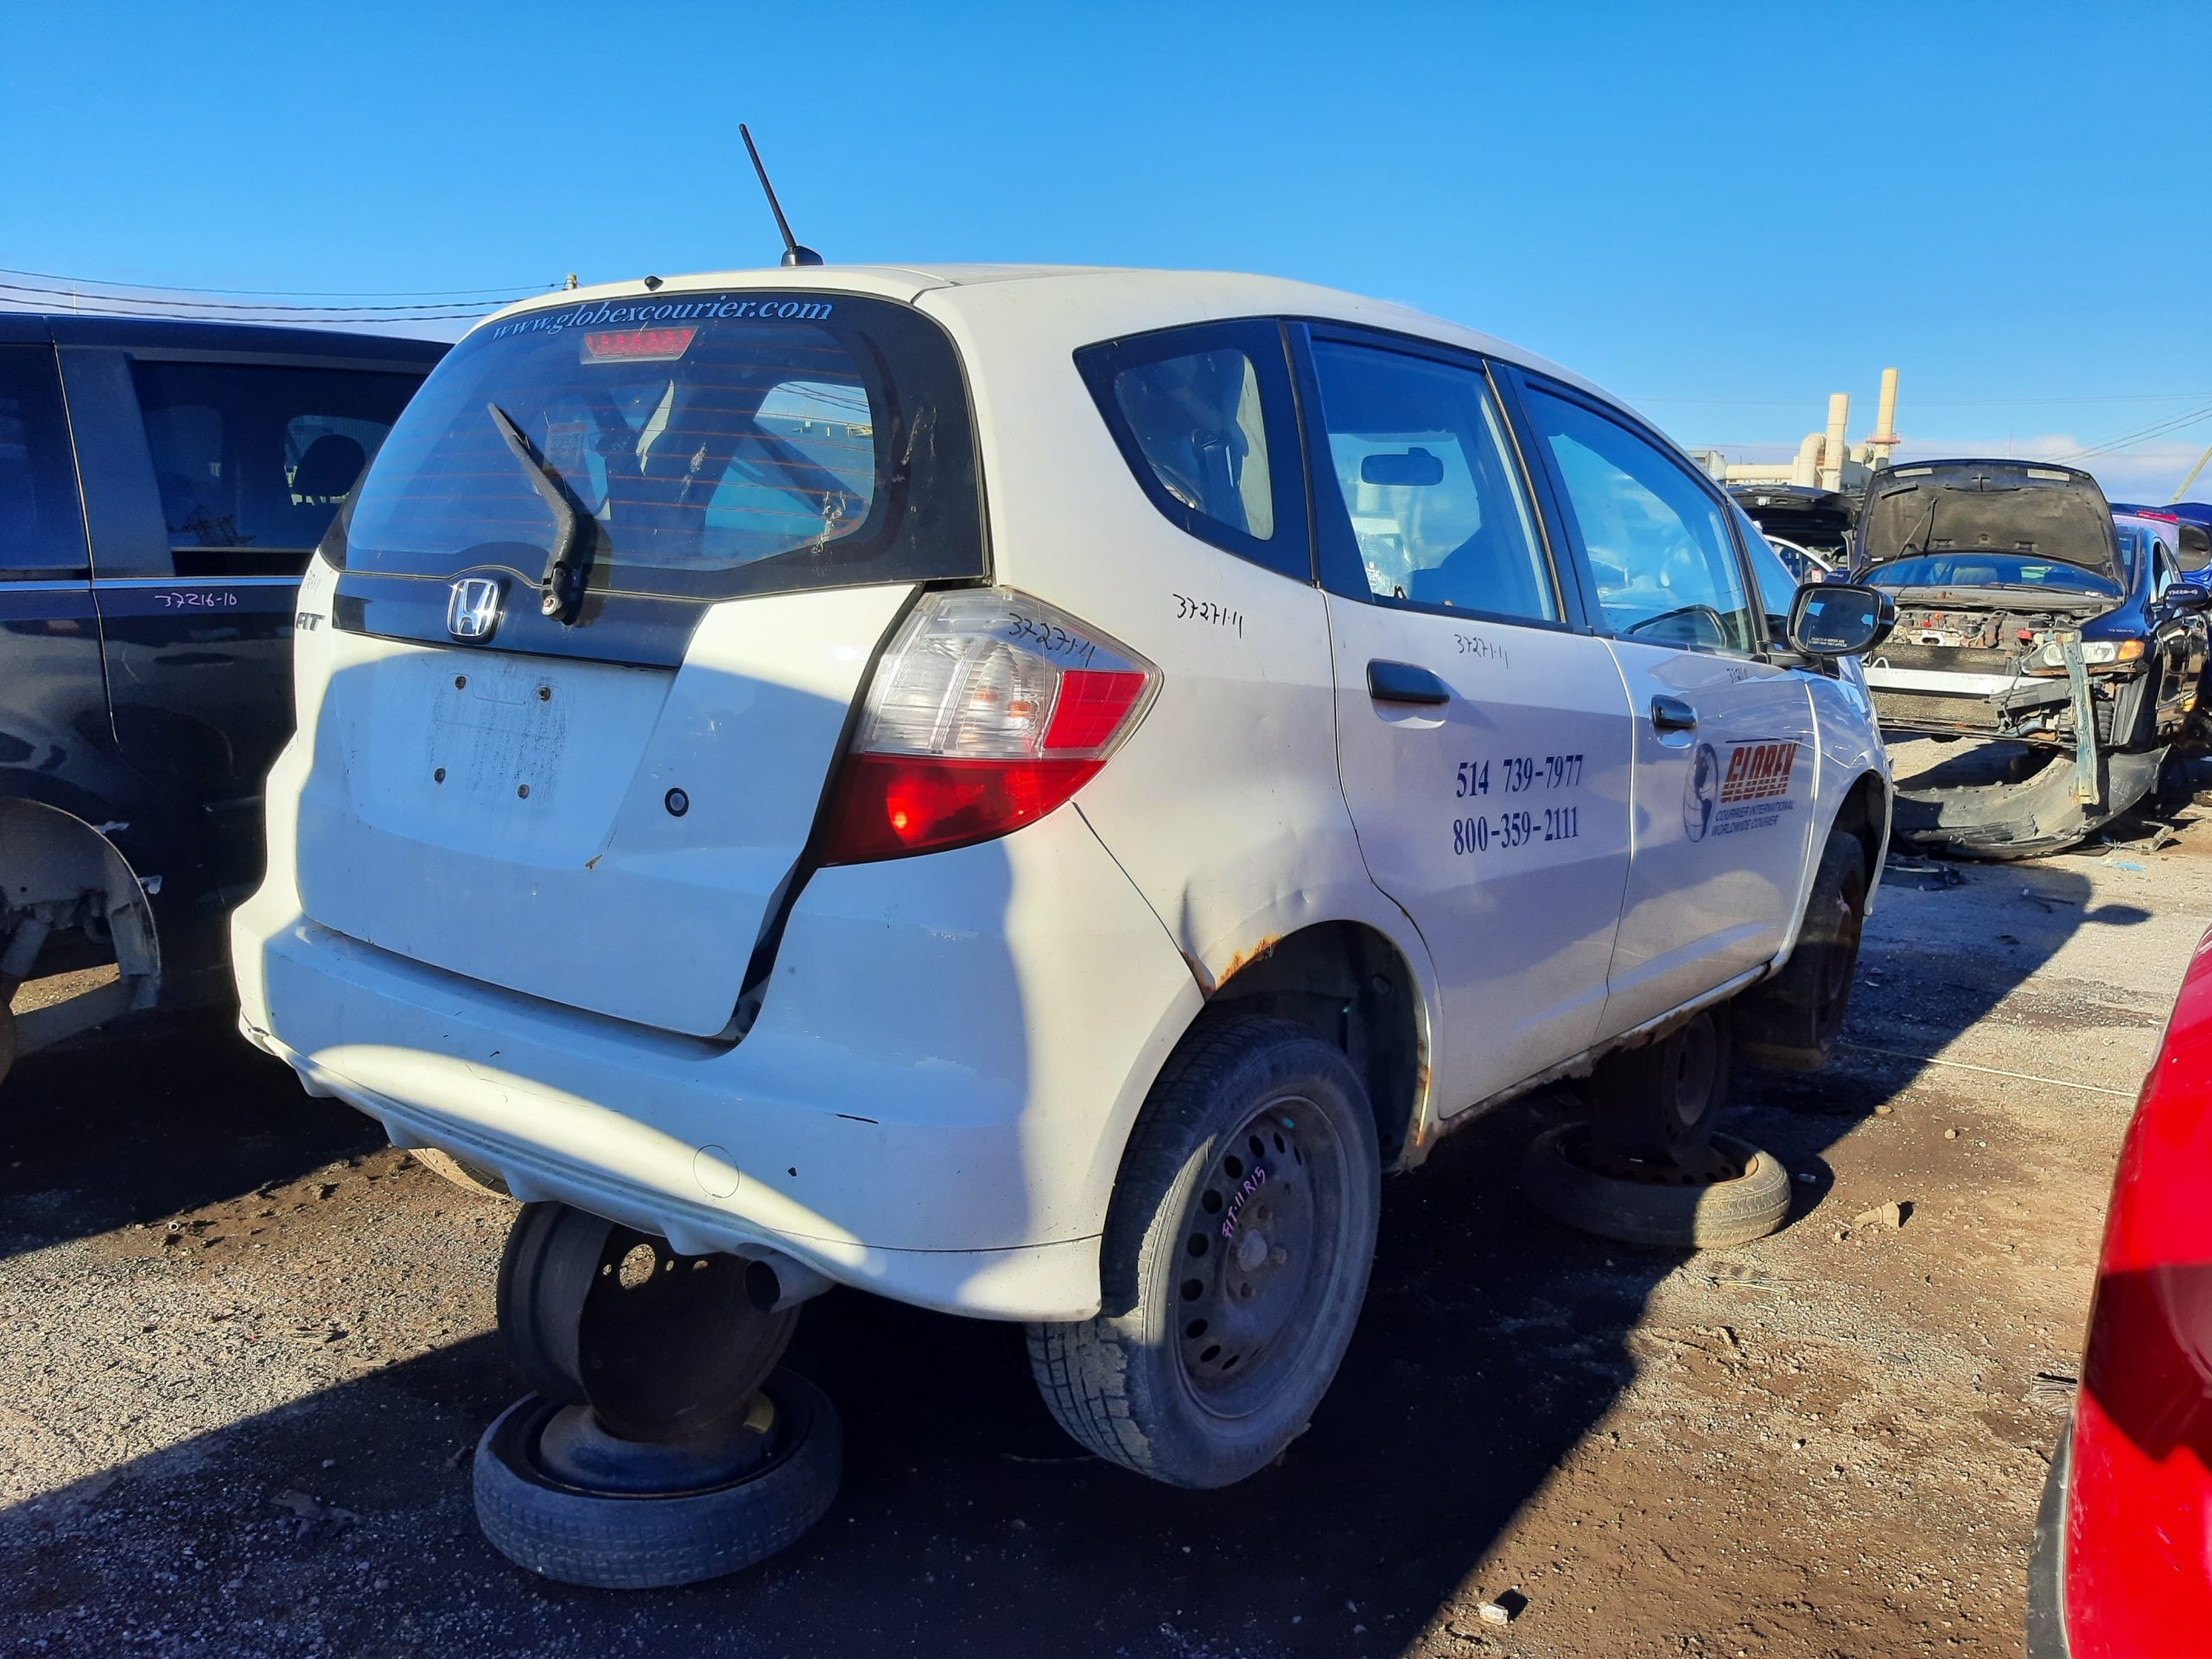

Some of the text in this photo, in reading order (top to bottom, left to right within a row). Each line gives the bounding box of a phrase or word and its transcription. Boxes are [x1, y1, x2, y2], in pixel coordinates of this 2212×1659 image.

[492, 295, 834, 340] www.globexcourier.com
[155, 593, 238, 608] 37216-10
[1456, 754, 1584, 798] 514 739-7977
[1720, 744, 1798, 804] GLOBEX
[1452, 805, 1580, 855] 800-359-2111
[1712, 816, 1778, 836] WORLDWIDE COURIER
[1748, 800, 1796, 817] INTERNATIONAL
